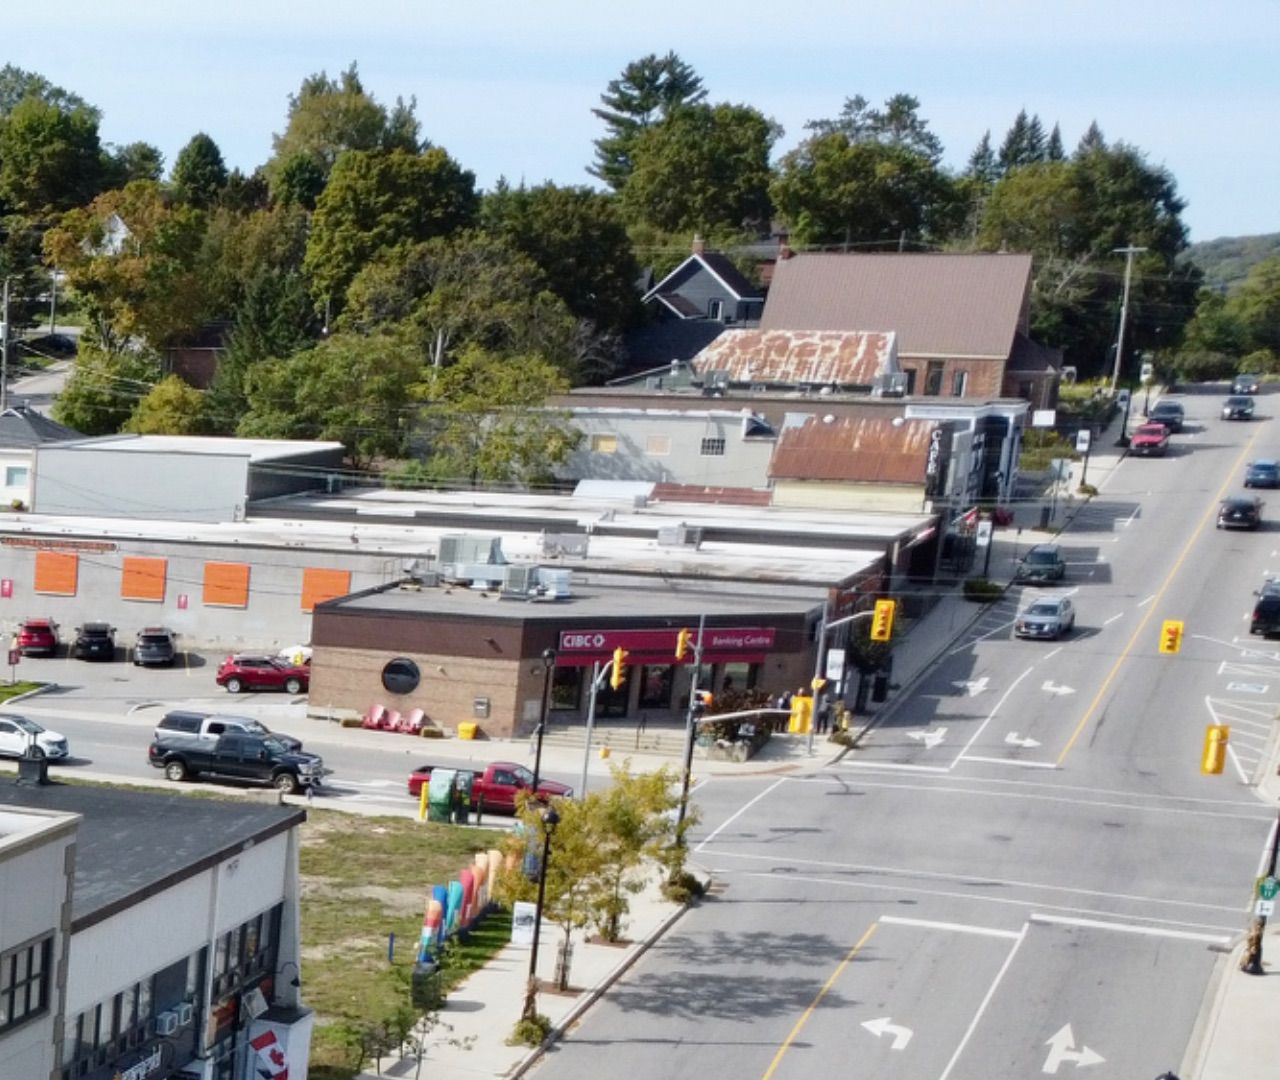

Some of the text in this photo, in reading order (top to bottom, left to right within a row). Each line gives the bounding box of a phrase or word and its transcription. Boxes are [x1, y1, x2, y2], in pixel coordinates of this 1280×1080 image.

[563, 634, 591, 647] CIBC
[712, 635, 771, 647] Banking Centre
